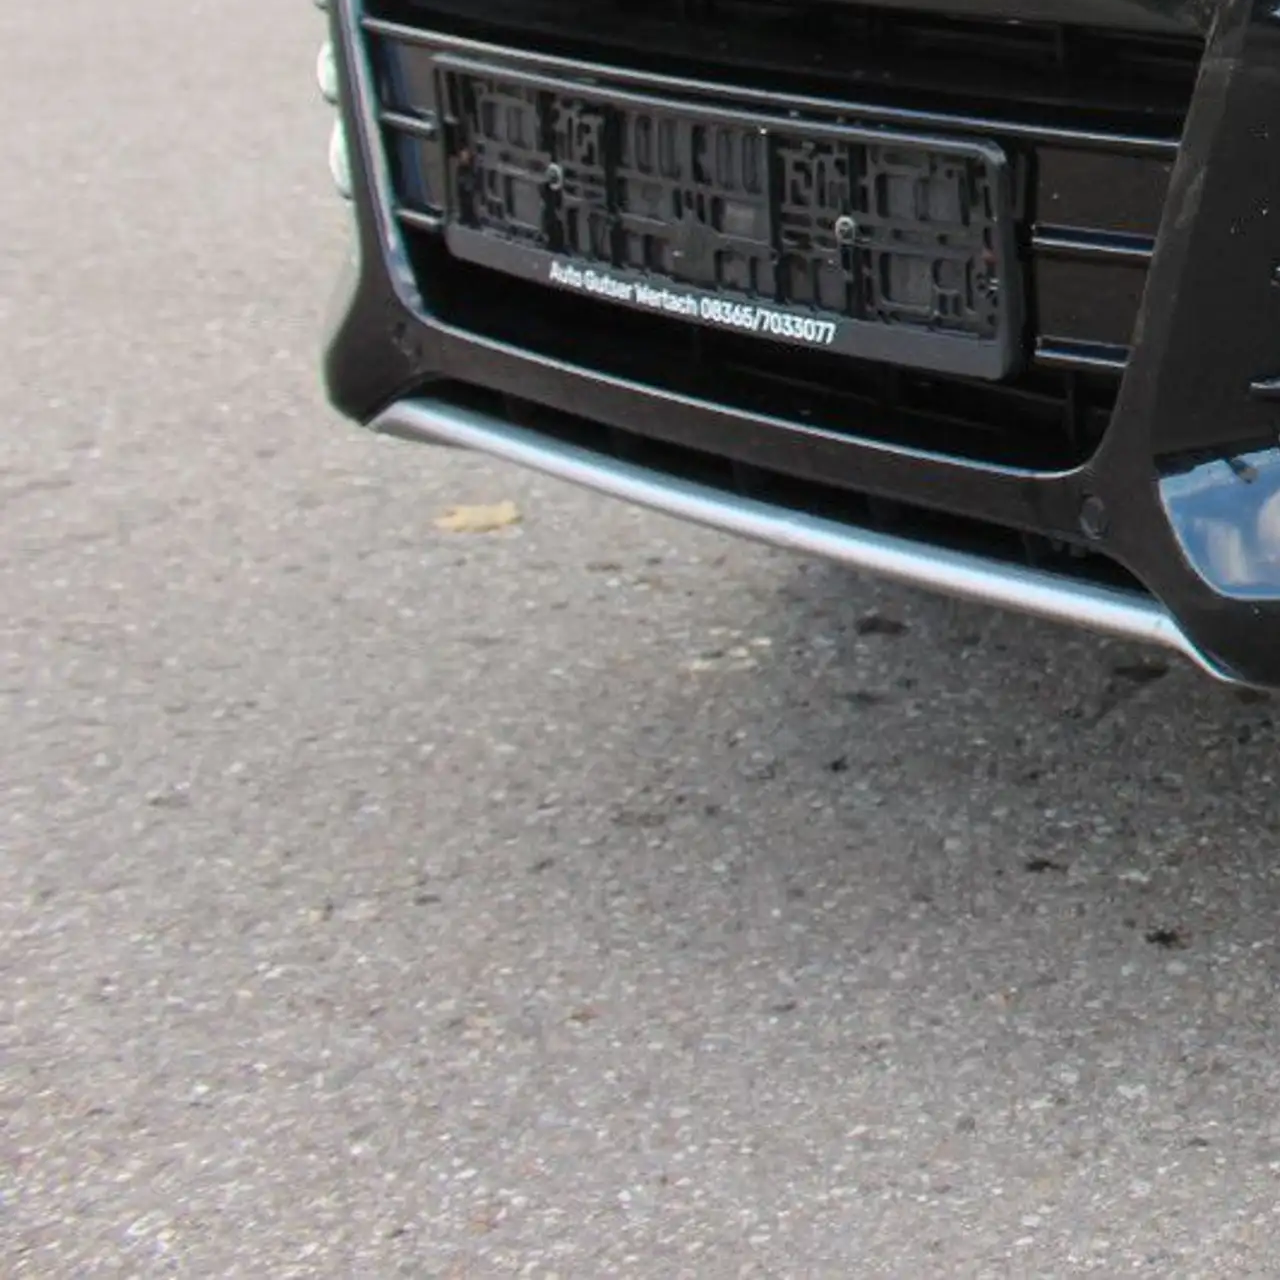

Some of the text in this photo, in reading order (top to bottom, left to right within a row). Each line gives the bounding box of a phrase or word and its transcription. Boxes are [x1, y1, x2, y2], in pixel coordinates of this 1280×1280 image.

[550, 260, 582, 289] Auto
[635, 281, 698, 317] Wertach
[700, 297, 837, 345] 08365/7033077
